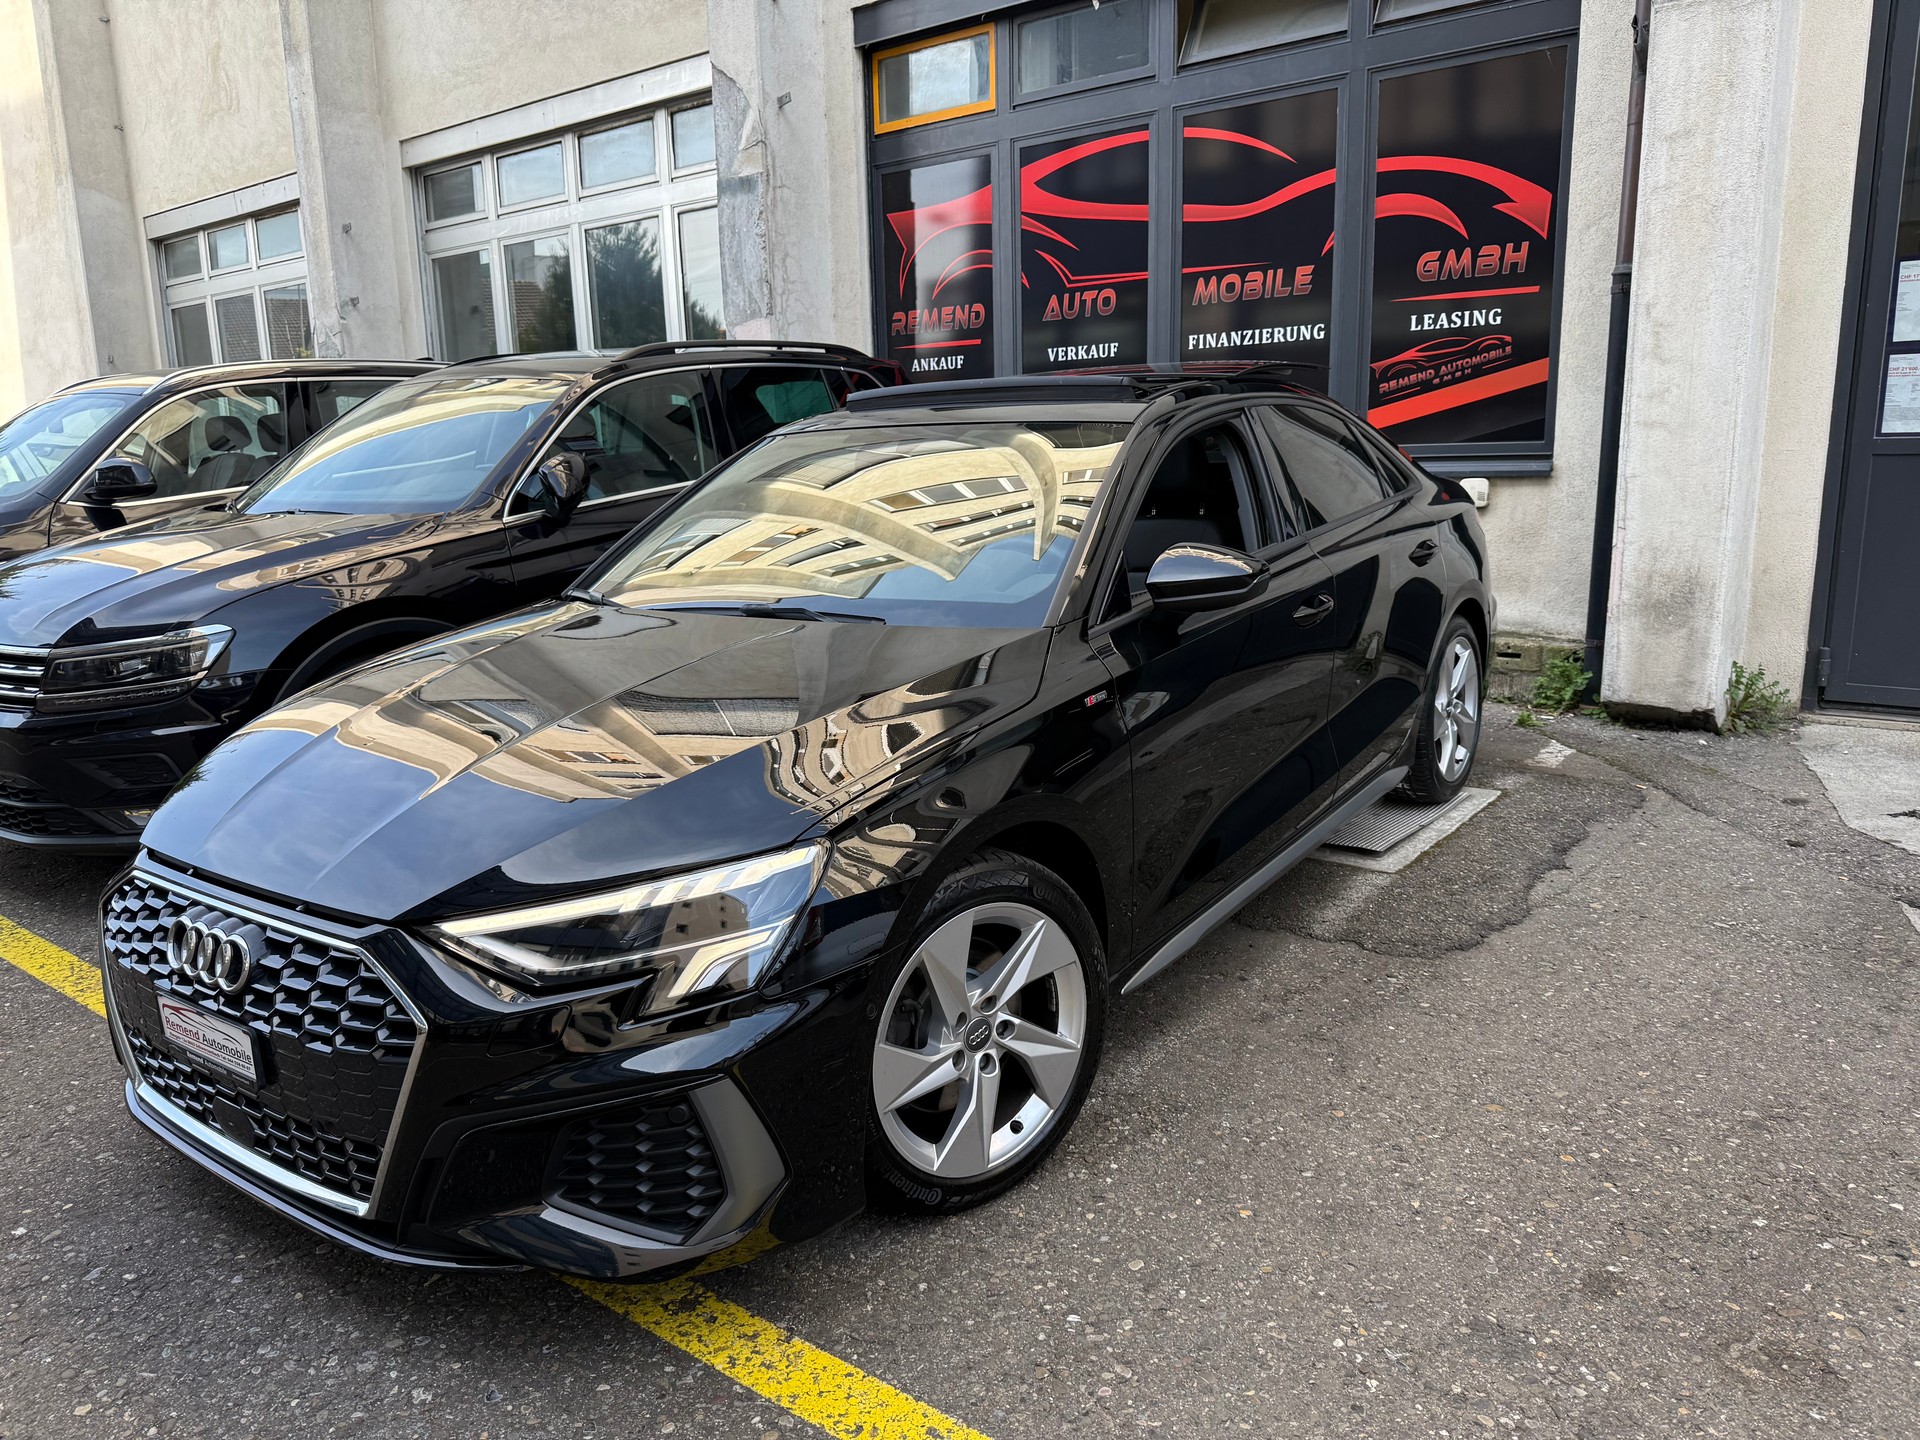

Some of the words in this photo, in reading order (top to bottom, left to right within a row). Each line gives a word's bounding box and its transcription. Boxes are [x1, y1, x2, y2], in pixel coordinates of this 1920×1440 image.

[891, 303, 986, 336] REMEND
[1041, 288, 1117, 322] AUTO
[1191, 264, 1315, 306] MOBILE
[1416, 241, 1530, 282] GMBH
[1410, 308, 1503, 331] LEASING
[1187, 323, 1325, 350] FINANZIERUNG
[911, 355, 965, 373] ANKAUF
[1047, 342, 1119, 362] VERKAUF
[1379, 369, 1435, 394] REMEND
[1438, 345, 1512, 376] AUTOMOBILE
[165, 1016, 200, 1040] Remend
[202, 1033, 252, 1063] Automobile
